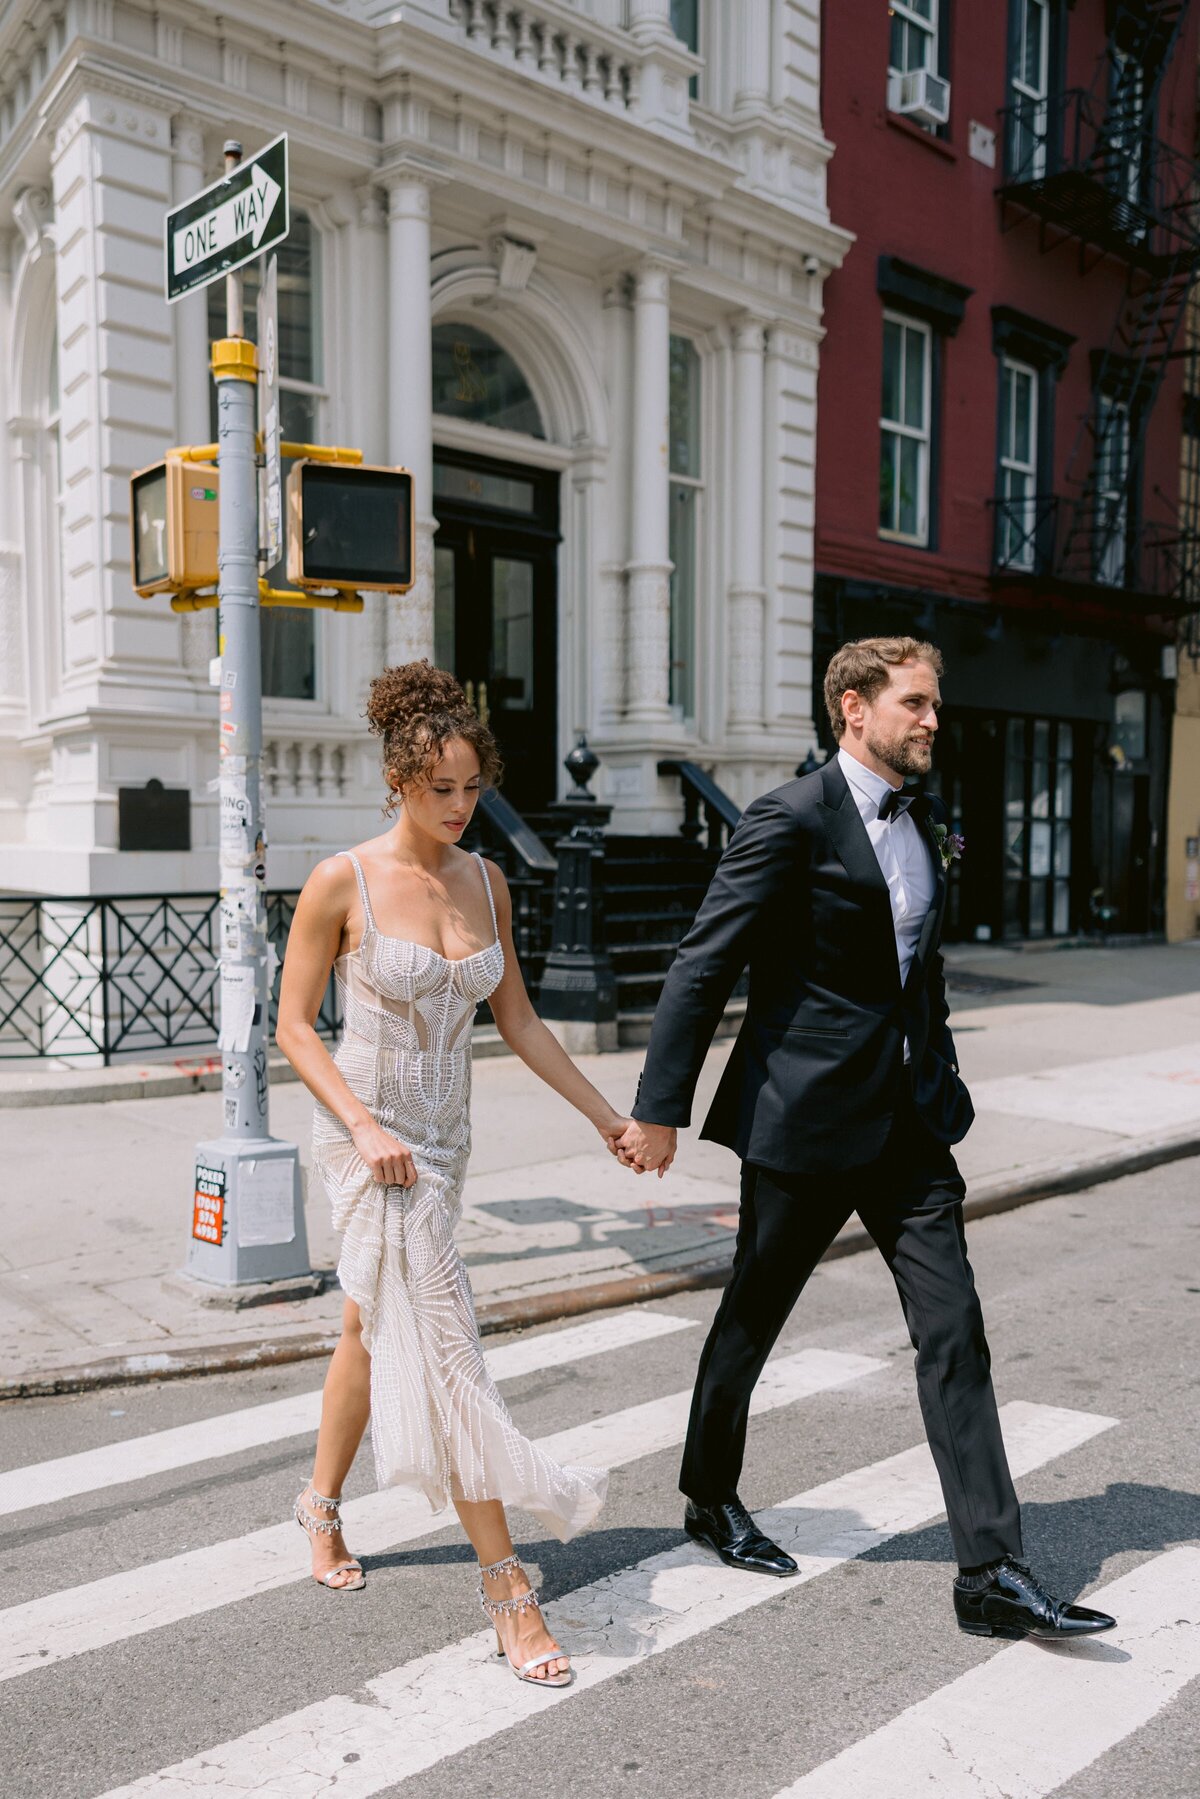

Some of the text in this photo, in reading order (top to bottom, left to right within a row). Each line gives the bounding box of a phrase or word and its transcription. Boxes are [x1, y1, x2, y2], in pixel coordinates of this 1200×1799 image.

[184, 181, 269, 263] ONE WAY
[197, 1167, 225, 1186] POKER
[198, 1180, 220, 1197] CLUB
